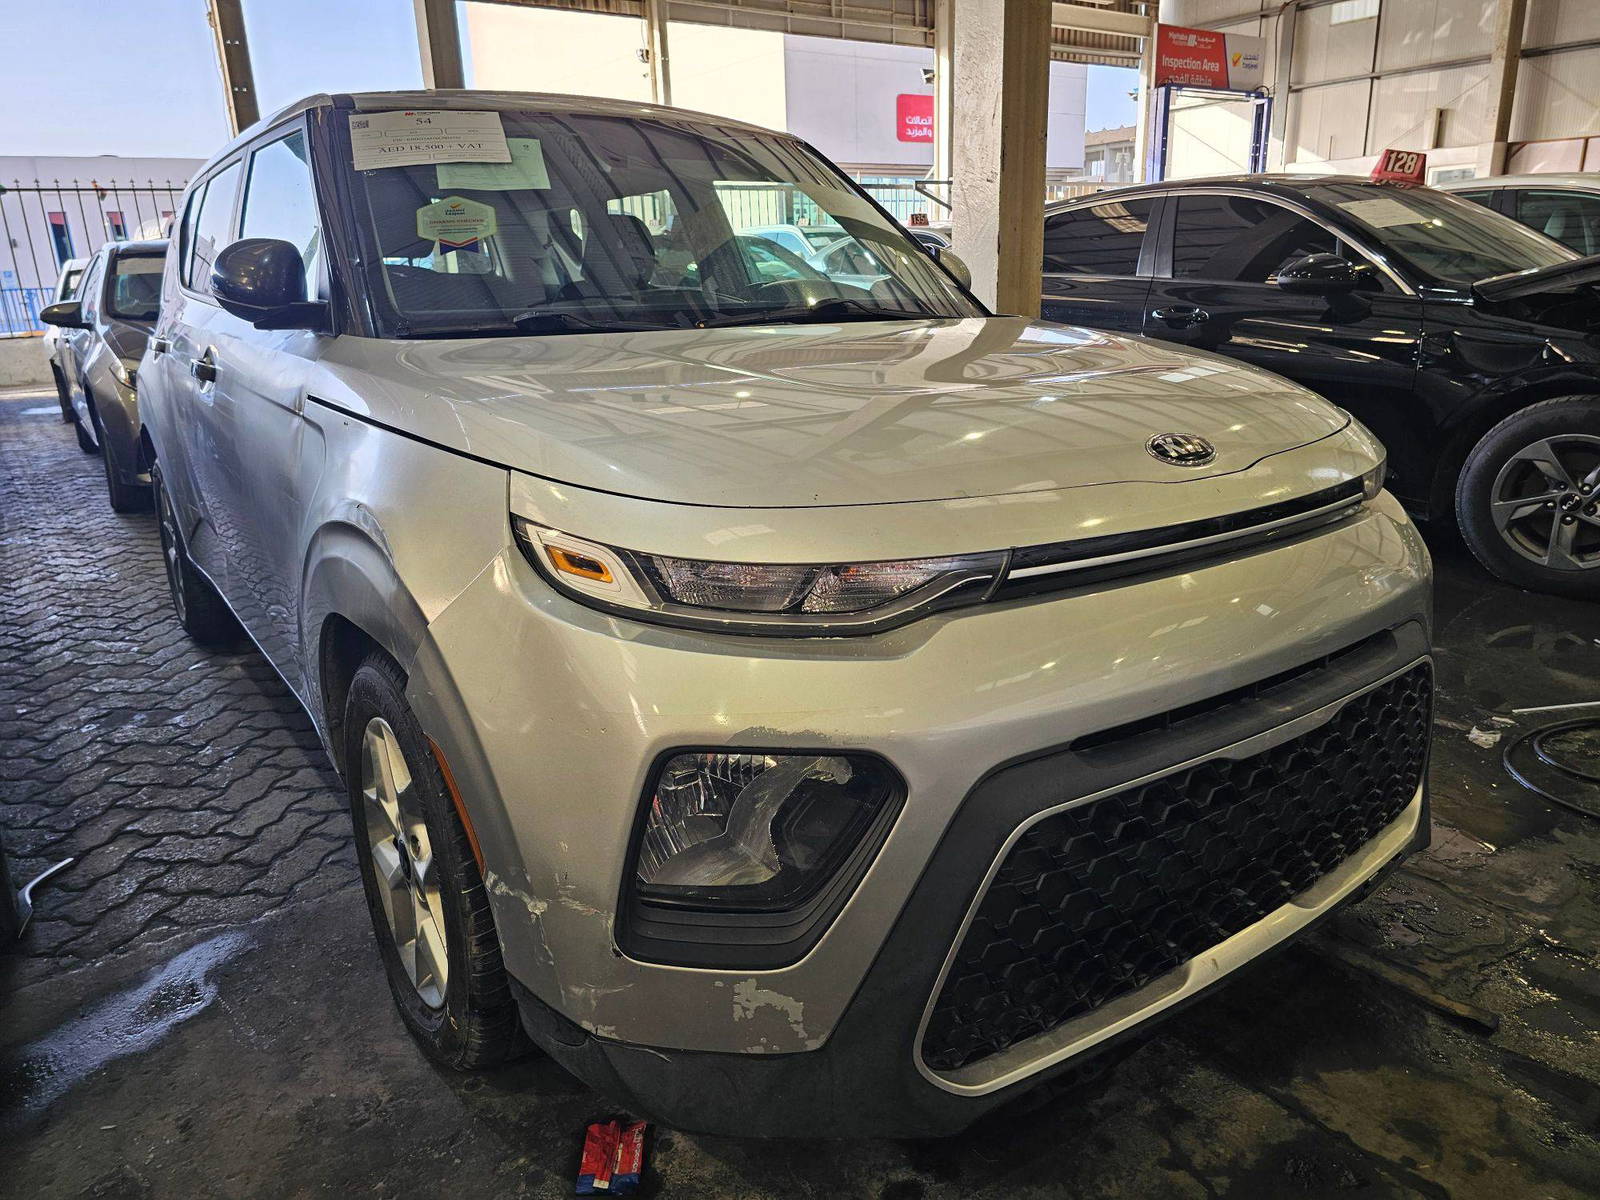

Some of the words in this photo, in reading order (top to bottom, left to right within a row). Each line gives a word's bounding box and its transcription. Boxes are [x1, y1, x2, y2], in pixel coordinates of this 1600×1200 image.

[1162, 54, 1201, 71] Inspection
[1202, 59, 1220, 72] Area
[416, 118, 432, 126] 54
[905, 127, 933, 138] والمزيد
[409, 144, 444, 152] 18,500
[1386, 151, 1418, 174] 128
[913, 214, 925, 224] 135
